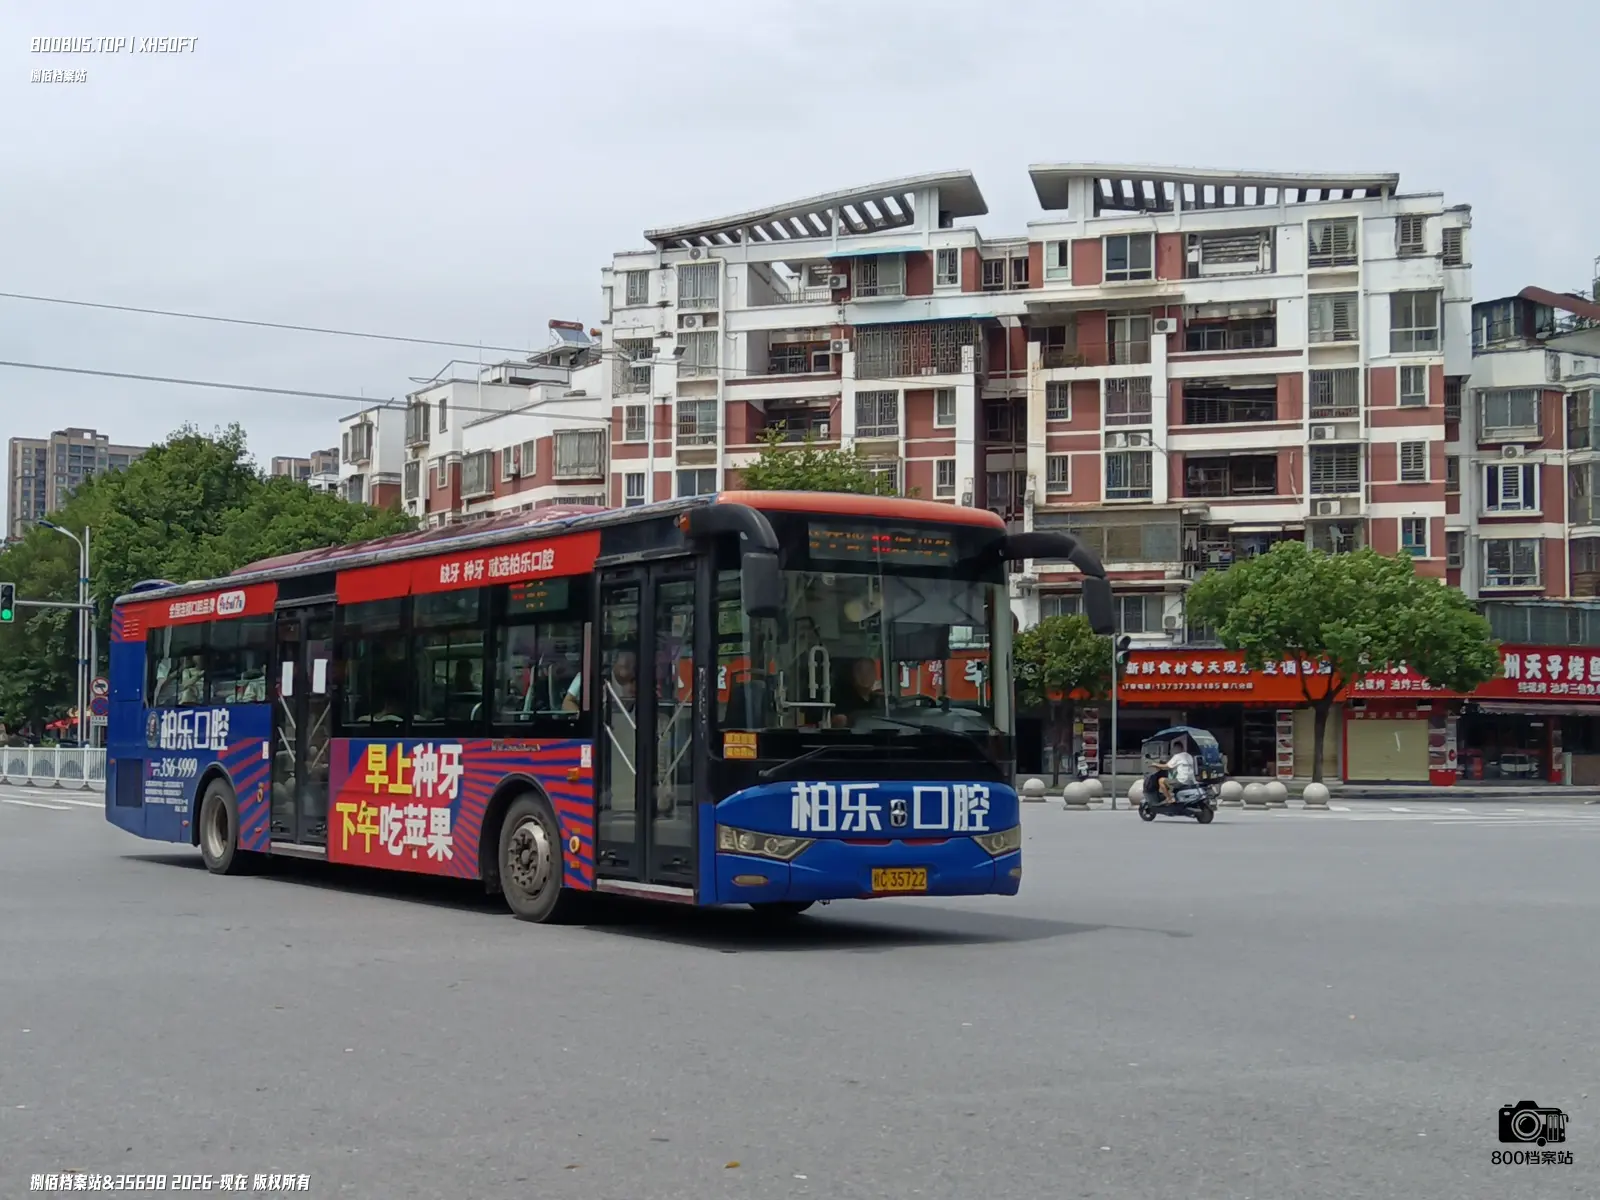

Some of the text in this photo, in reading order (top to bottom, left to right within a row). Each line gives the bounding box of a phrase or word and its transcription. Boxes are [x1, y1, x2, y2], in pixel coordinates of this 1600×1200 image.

[463, 559, 485, 581] 种牙
[160, 708, 230, 750] 柏乐口腔
[365, 742, 464, 799] 早上种牙
[336, 800, 453, 861] 下午吃苹果
[791, 782, 990, 831] 柏乐 口腔
